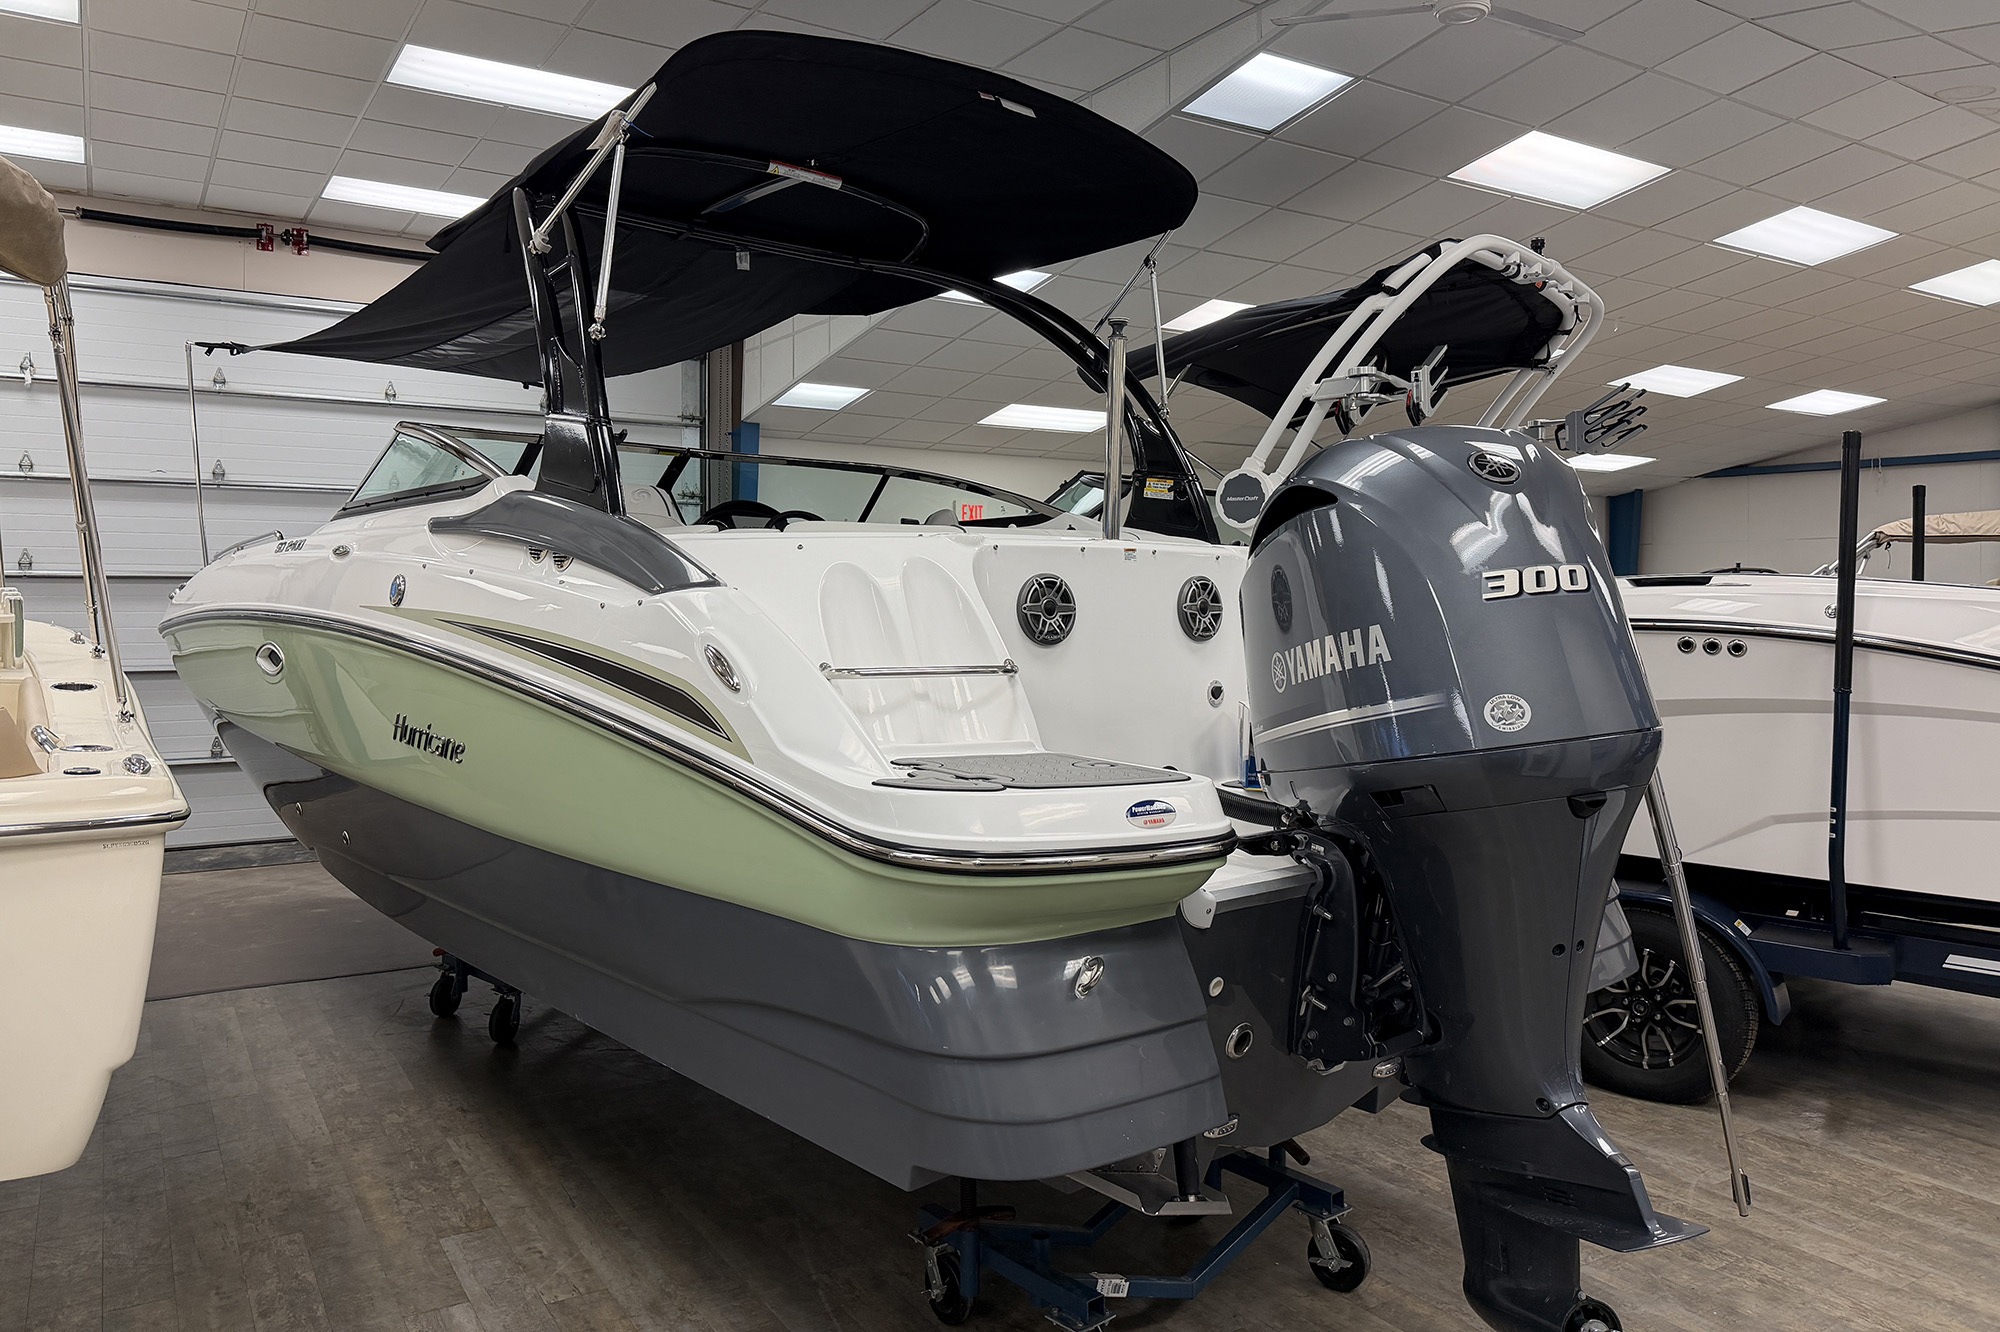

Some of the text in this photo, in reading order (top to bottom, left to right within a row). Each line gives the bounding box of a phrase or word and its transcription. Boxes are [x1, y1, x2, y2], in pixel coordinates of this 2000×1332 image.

[962, 504, 984, 521] EXIT
[1482, 564, 1588, 600] 300
[1285, 624, 1392, 686] YAMAHA
[393, 712, 466, 764] Hurricane
